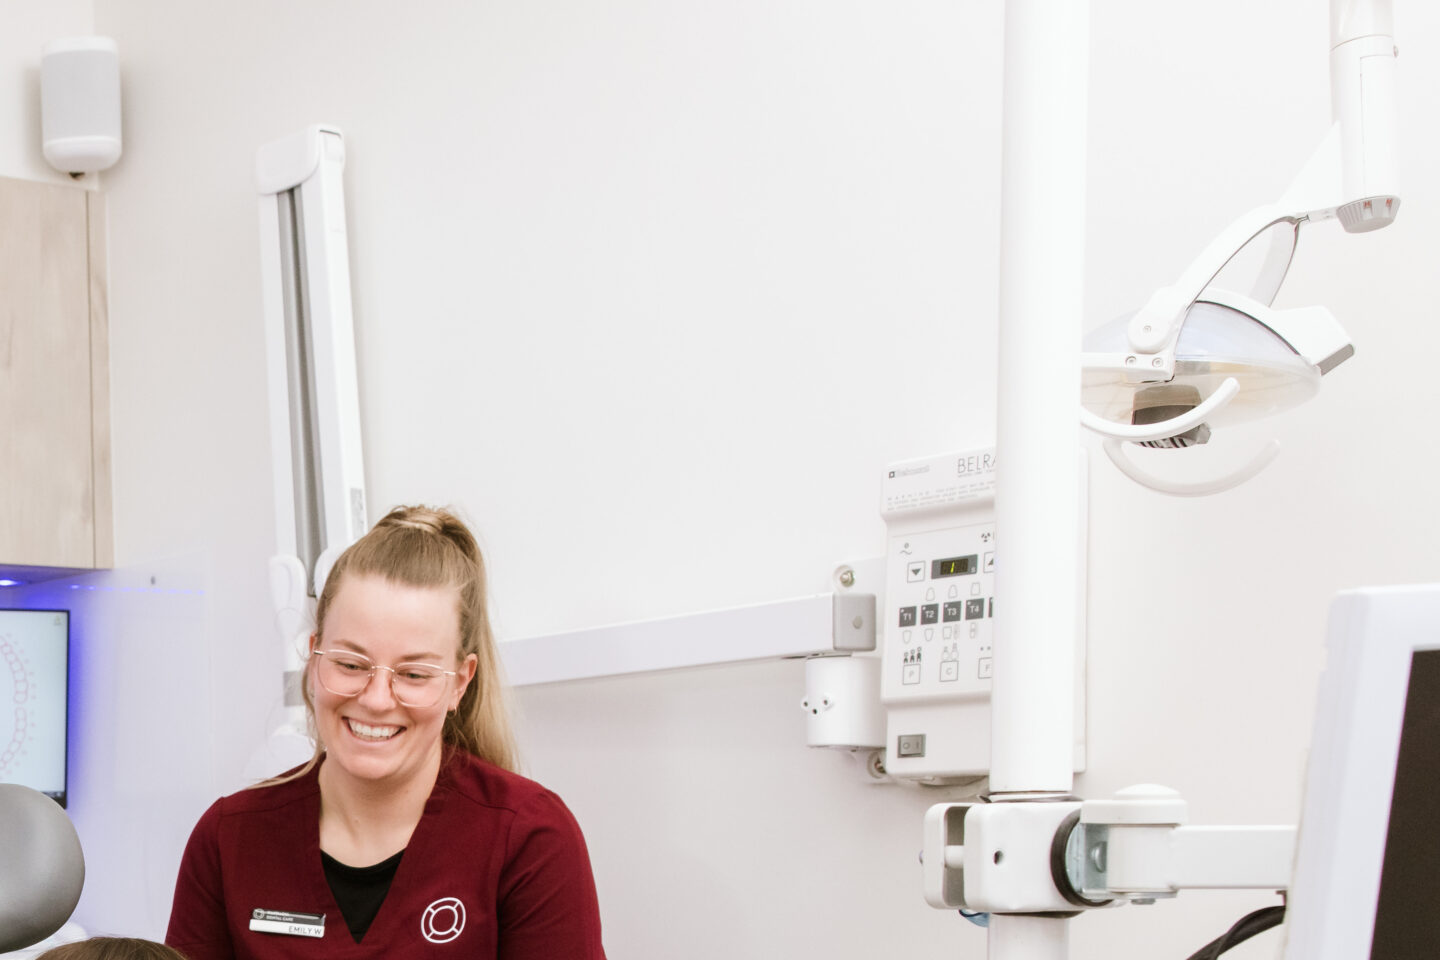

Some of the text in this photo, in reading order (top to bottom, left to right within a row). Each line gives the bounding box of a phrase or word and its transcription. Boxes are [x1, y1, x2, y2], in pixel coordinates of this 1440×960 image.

[947, 607, 957, 617] T3
[969, 604, 980, 614] T4
[903, 613, 912, 621] T1
[925, 610, 935, 619] T2
[288, 925, 312, 935] EMILY
